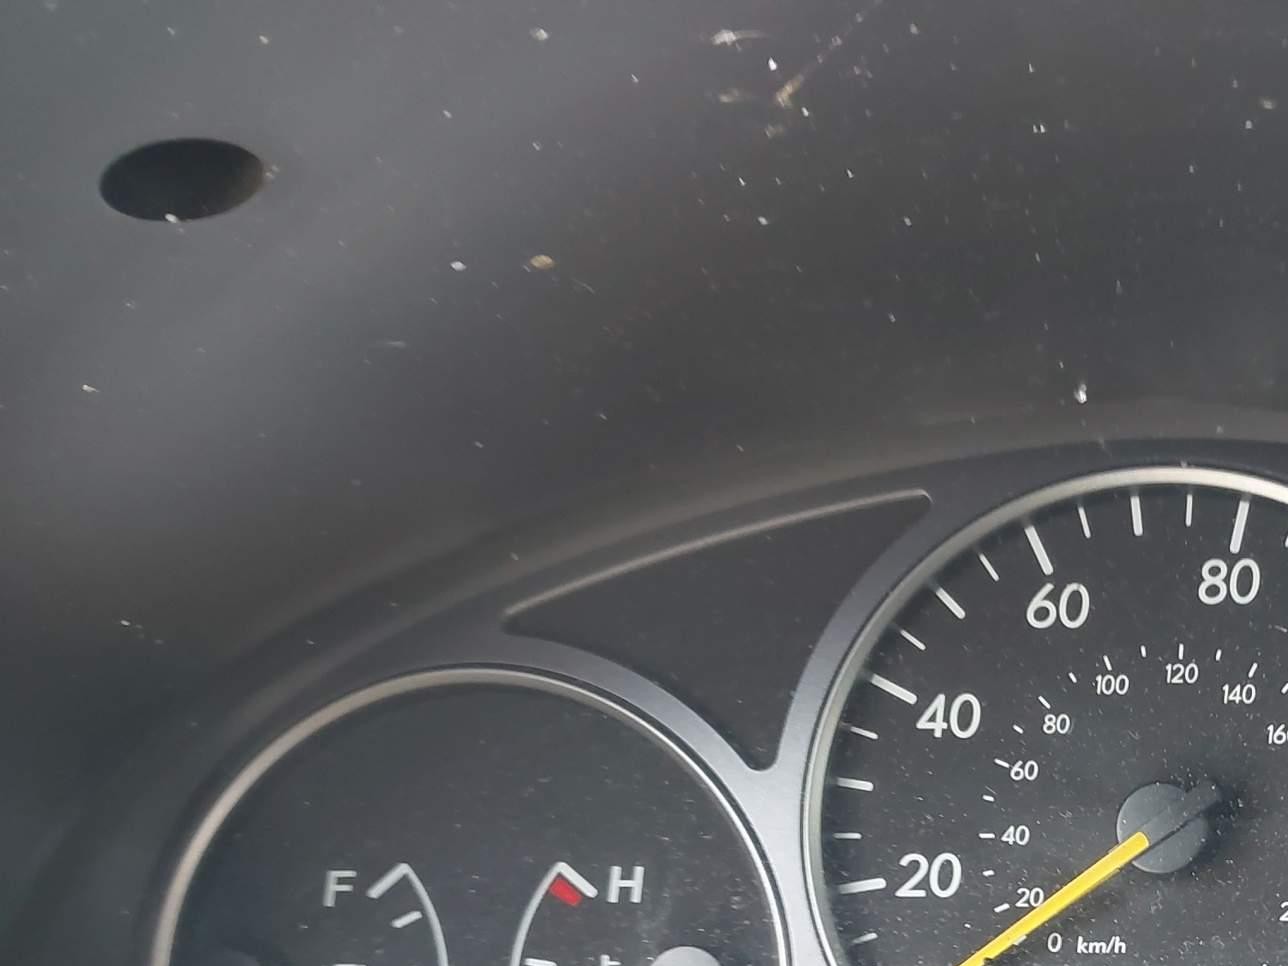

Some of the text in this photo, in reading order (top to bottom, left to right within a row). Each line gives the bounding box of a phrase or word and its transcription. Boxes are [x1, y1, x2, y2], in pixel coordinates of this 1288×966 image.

[1198, 558, 1261, 605] 80
[1026, 583, 1090, 629] 60
[1165, 663, 1199, 684] 120
[1096, 674, 1129, 695] 100
[1222, 684, 1256, 704] 140
[915, 693, 982, 739] 40
[1043, 714, 1071, 735] 80
[1010, 761, 1039, 782] 60
[1000, 826, 1031, 846] 40
[607, 865, 645, 904] H
[894, 853, 963, 898] 20
[323, 870, 357, 907] F
[1015, 888, 1044, 908] 20
[1047, 933, 1127, 955] 0 km/h
